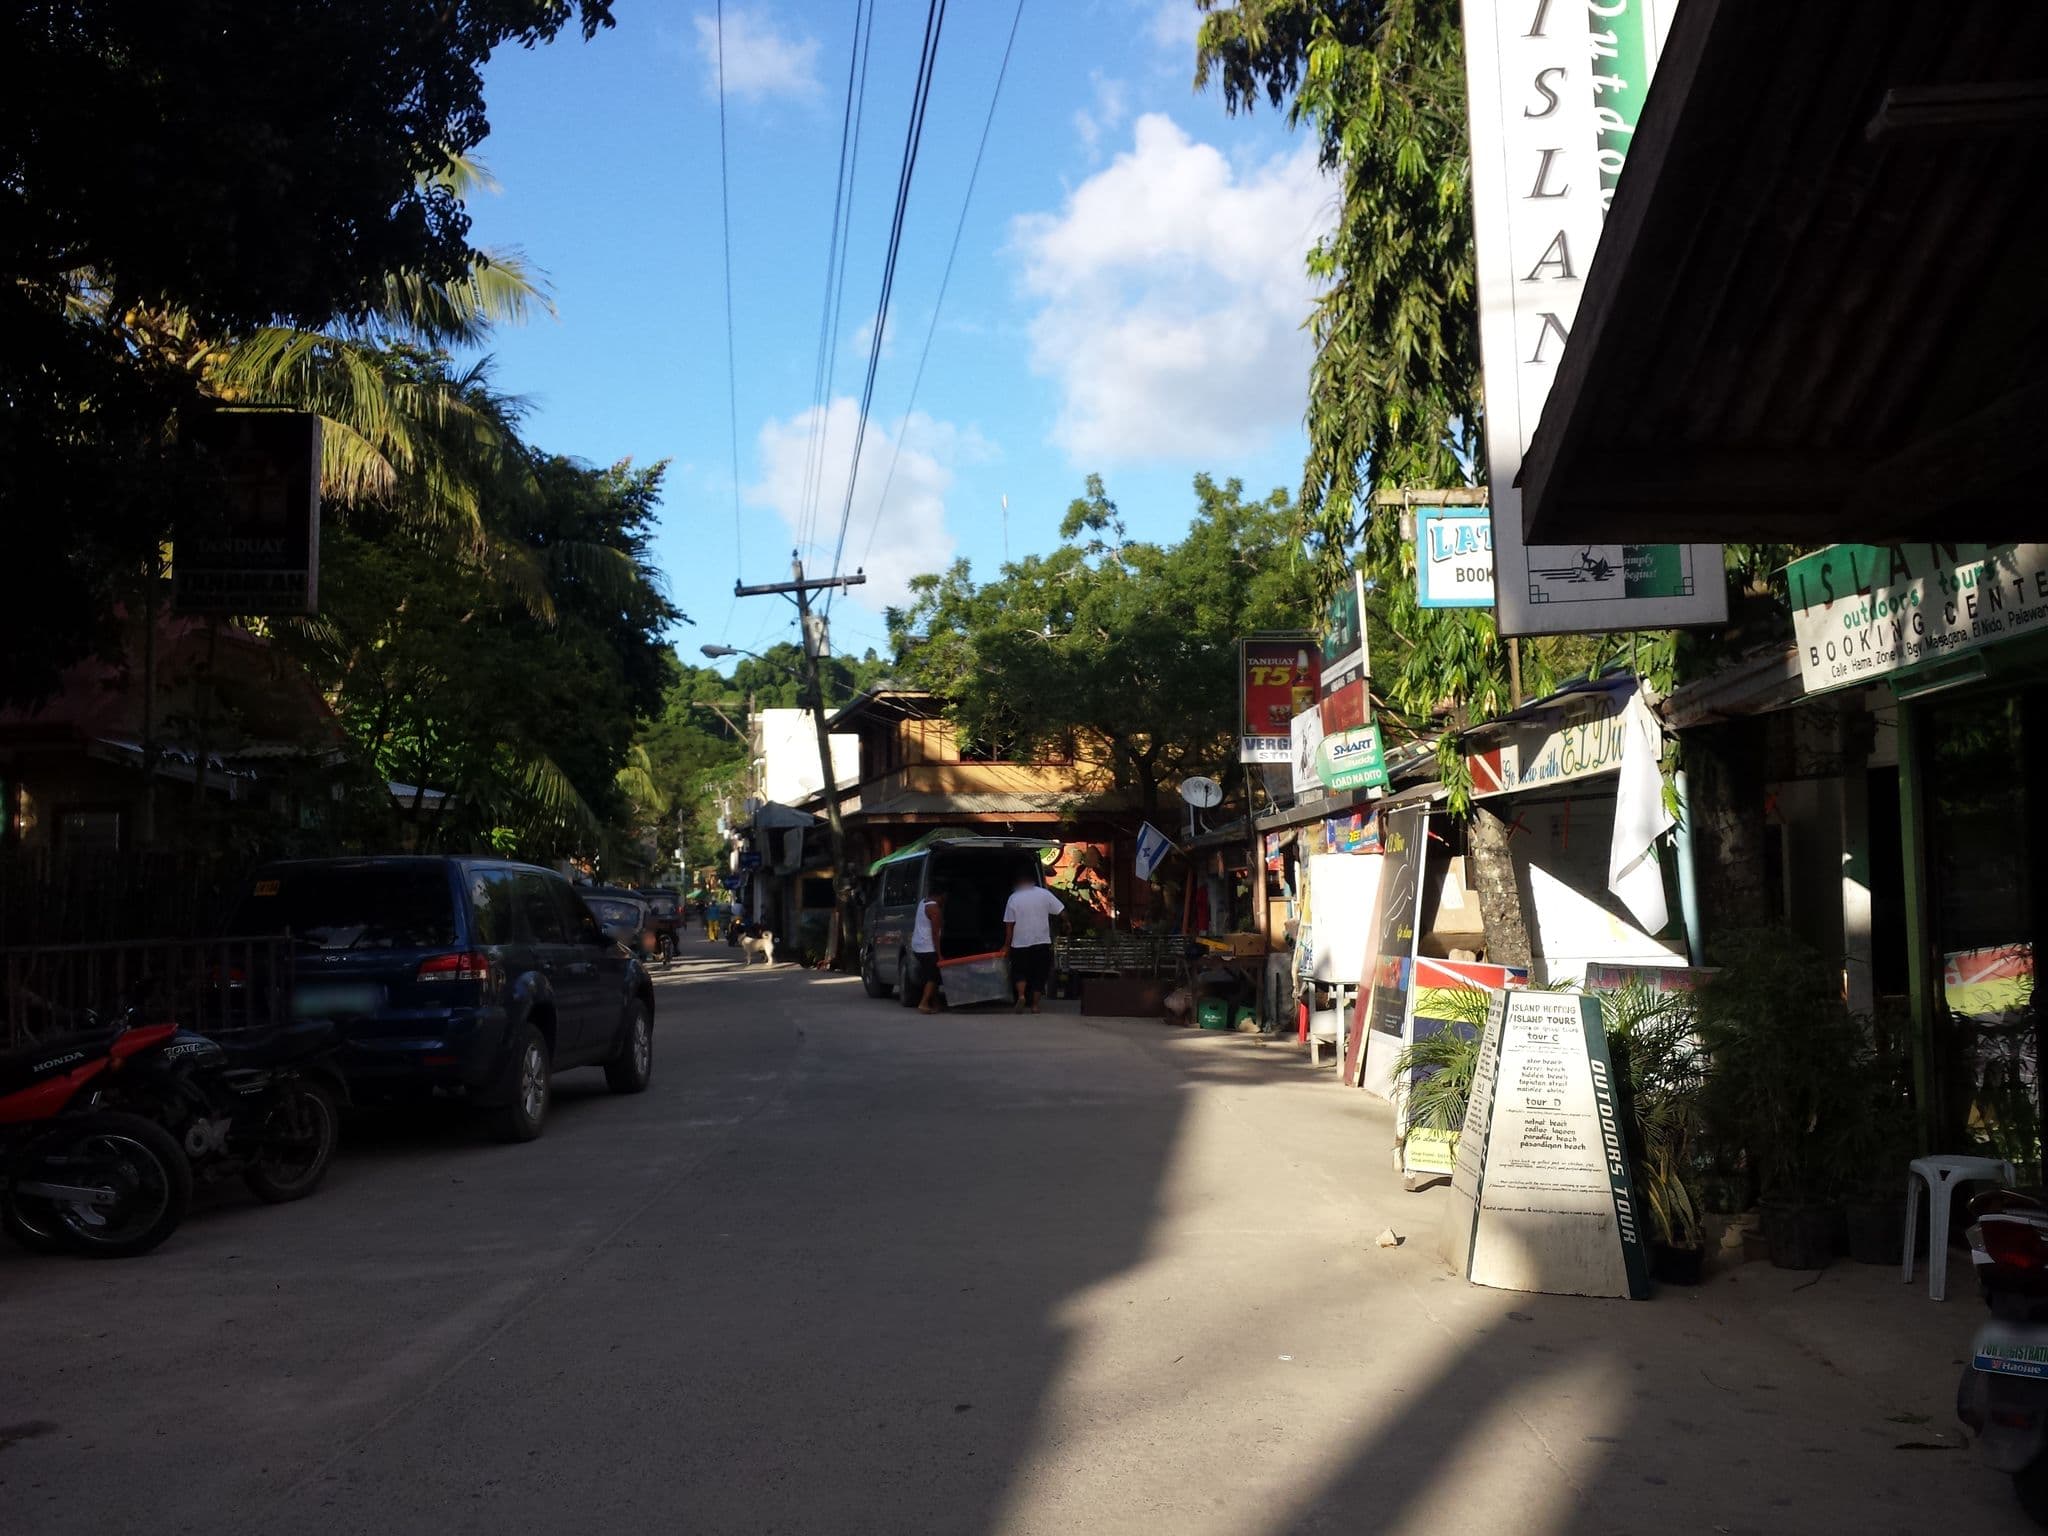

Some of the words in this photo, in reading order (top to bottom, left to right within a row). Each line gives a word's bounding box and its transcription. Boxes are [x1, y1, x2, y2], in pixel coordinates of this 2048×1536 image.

[1797, 543, 2003, 618] ISLAN
[1810, 611, 1925, 668] BOOKING
[1248, 658, 1295, 666] TANDUAY
[1876, 649, 1896, 665] Zone
[1250, 666, 1291, 686] T5
[1333, 738, 1373, 756] SMART
[1331, 775, 1353, 788] LOAD
[1353, 773, 1364, 783] NA
[1364, 769, 1382, 780] DITO
[1512, 1003, 1541, 1013] ISLAND
[1547, 1016, 1577, 1025] TOURS
[1527, 1032, 1548, 1041] tour
[1552, 1033, 1560, 1042] C
[32, 1050, 85, 1073] HONDA
[1526, 1097, 1547, 1106] tour
[1553, 1098, 1562, 1107] D
[1549, 1119, 1568, 1127] beach
[1590, 1058, 1625, 1177] OUTDOORS
[1613, 1186, 1637, 1244] TOUR
